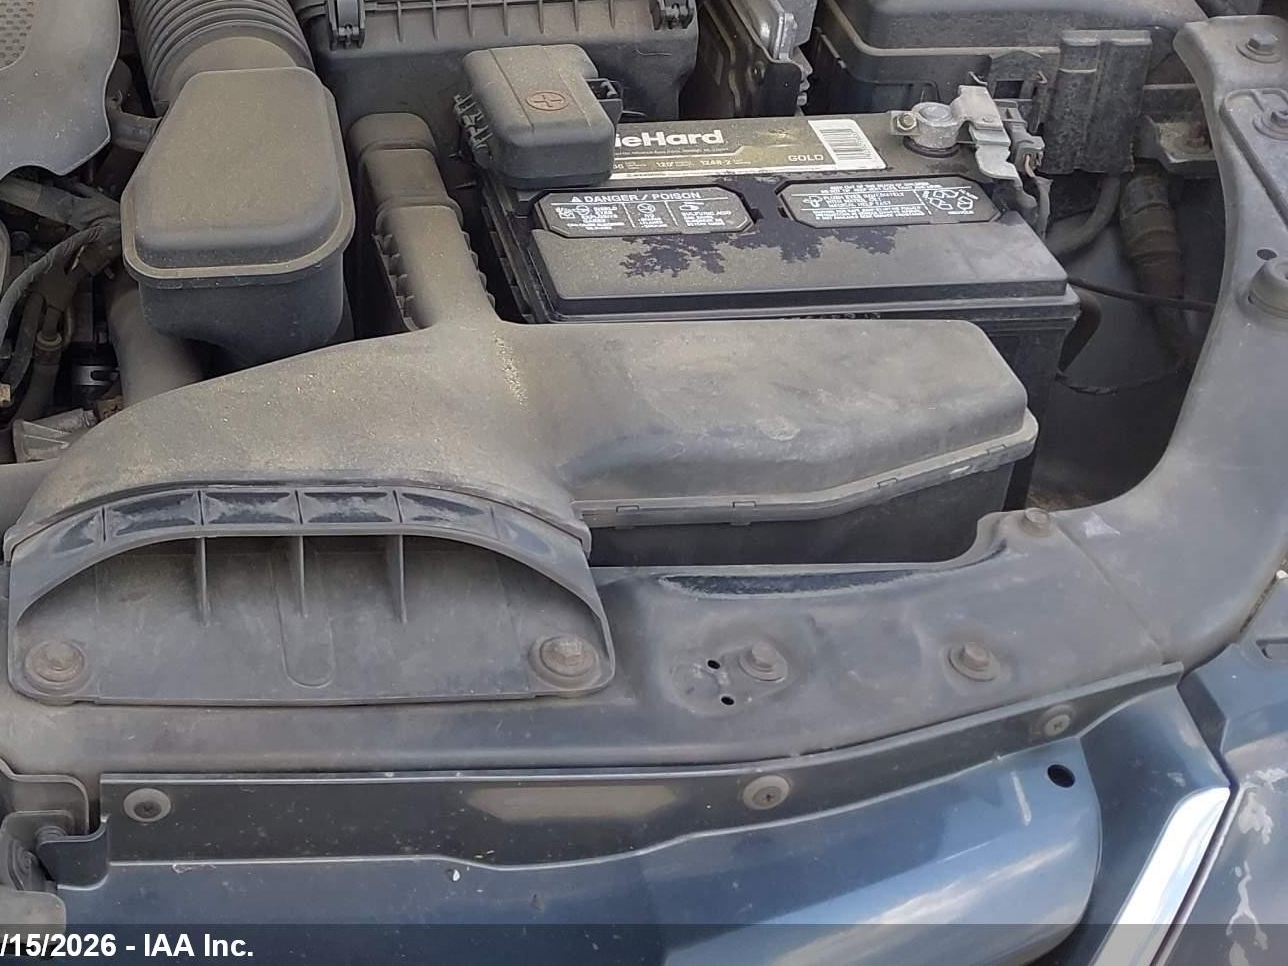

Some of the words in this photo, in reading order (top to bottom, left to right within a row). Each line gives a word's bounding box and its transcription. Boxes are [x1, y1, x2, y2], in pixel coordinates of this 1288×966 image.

[614, 129, 725, 148] ieHard
[788, 154, 824, 162] GOLD
[583, 194, 640, 203] DANGER
[652, 192, 702, 201] POISON
